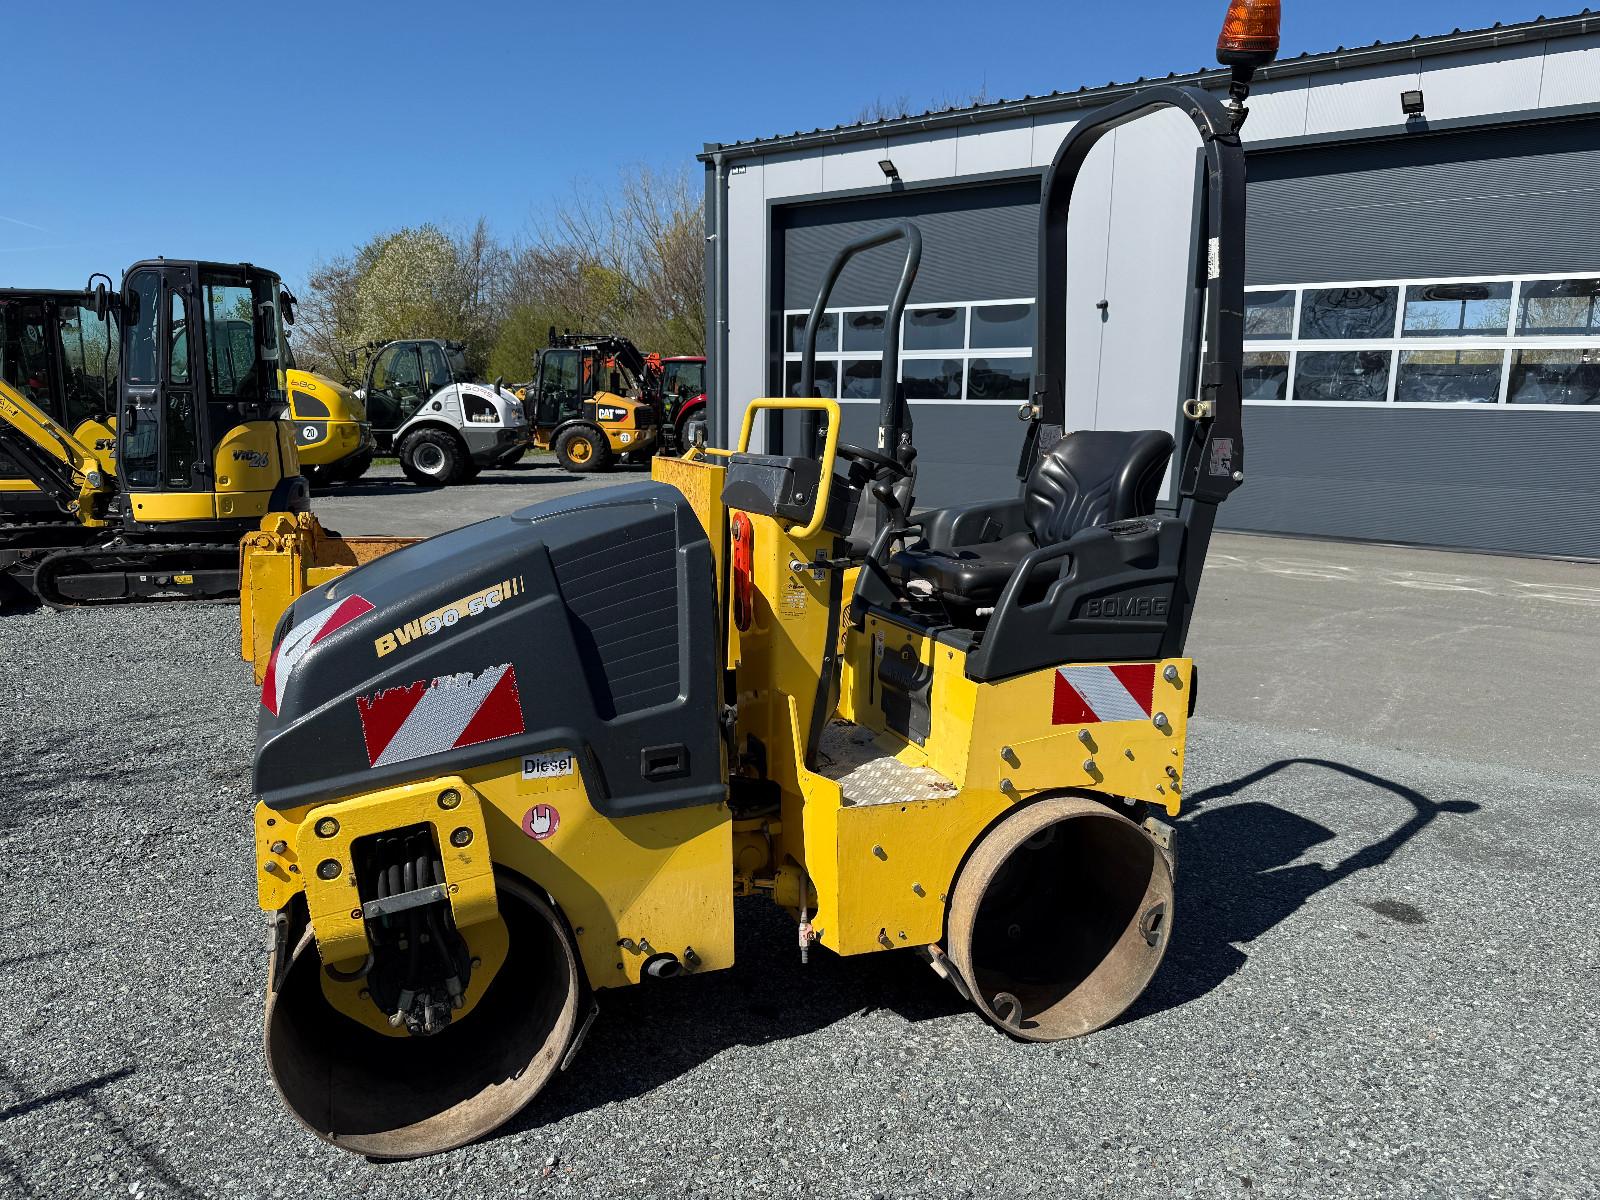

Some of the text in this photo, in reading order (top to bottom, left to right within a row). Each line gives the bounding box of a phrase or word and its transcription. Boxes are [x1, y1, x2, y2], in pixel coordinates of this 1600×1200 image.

[598, 408, 615, 420] CAT
[305, 428, 315, 438] 20
[1086, 597, 1168, 617] BOMAG
[524, 755, 572, 775] Diesel
